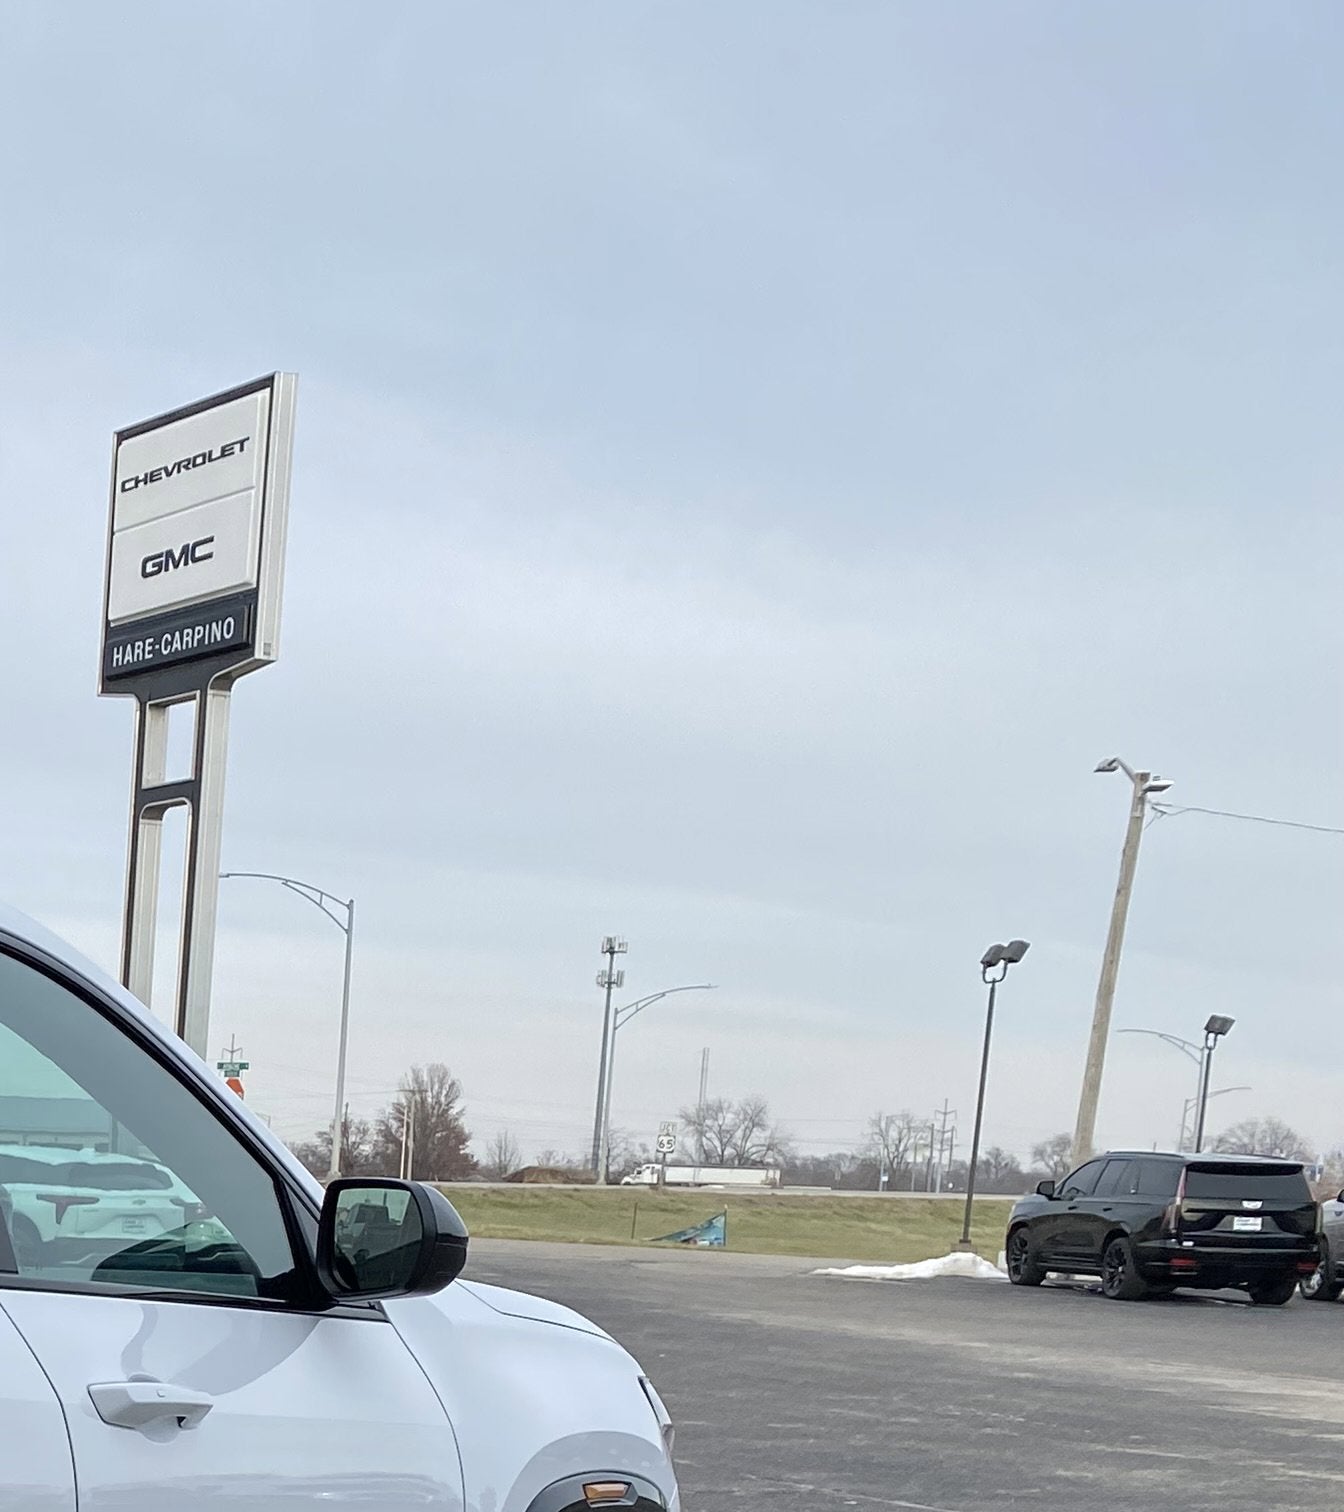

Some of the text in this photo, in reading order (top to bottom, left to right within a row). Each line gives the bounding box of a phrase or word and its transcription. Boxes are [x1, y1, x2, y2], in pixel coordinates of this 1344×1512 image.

[120, 436, 251, 493] CHEVROLET
[140, 536, 215, 579] GMC
[112, 616, 236, 667] HARE-CARPINO
[658, 1139, 673, 1149] 65
